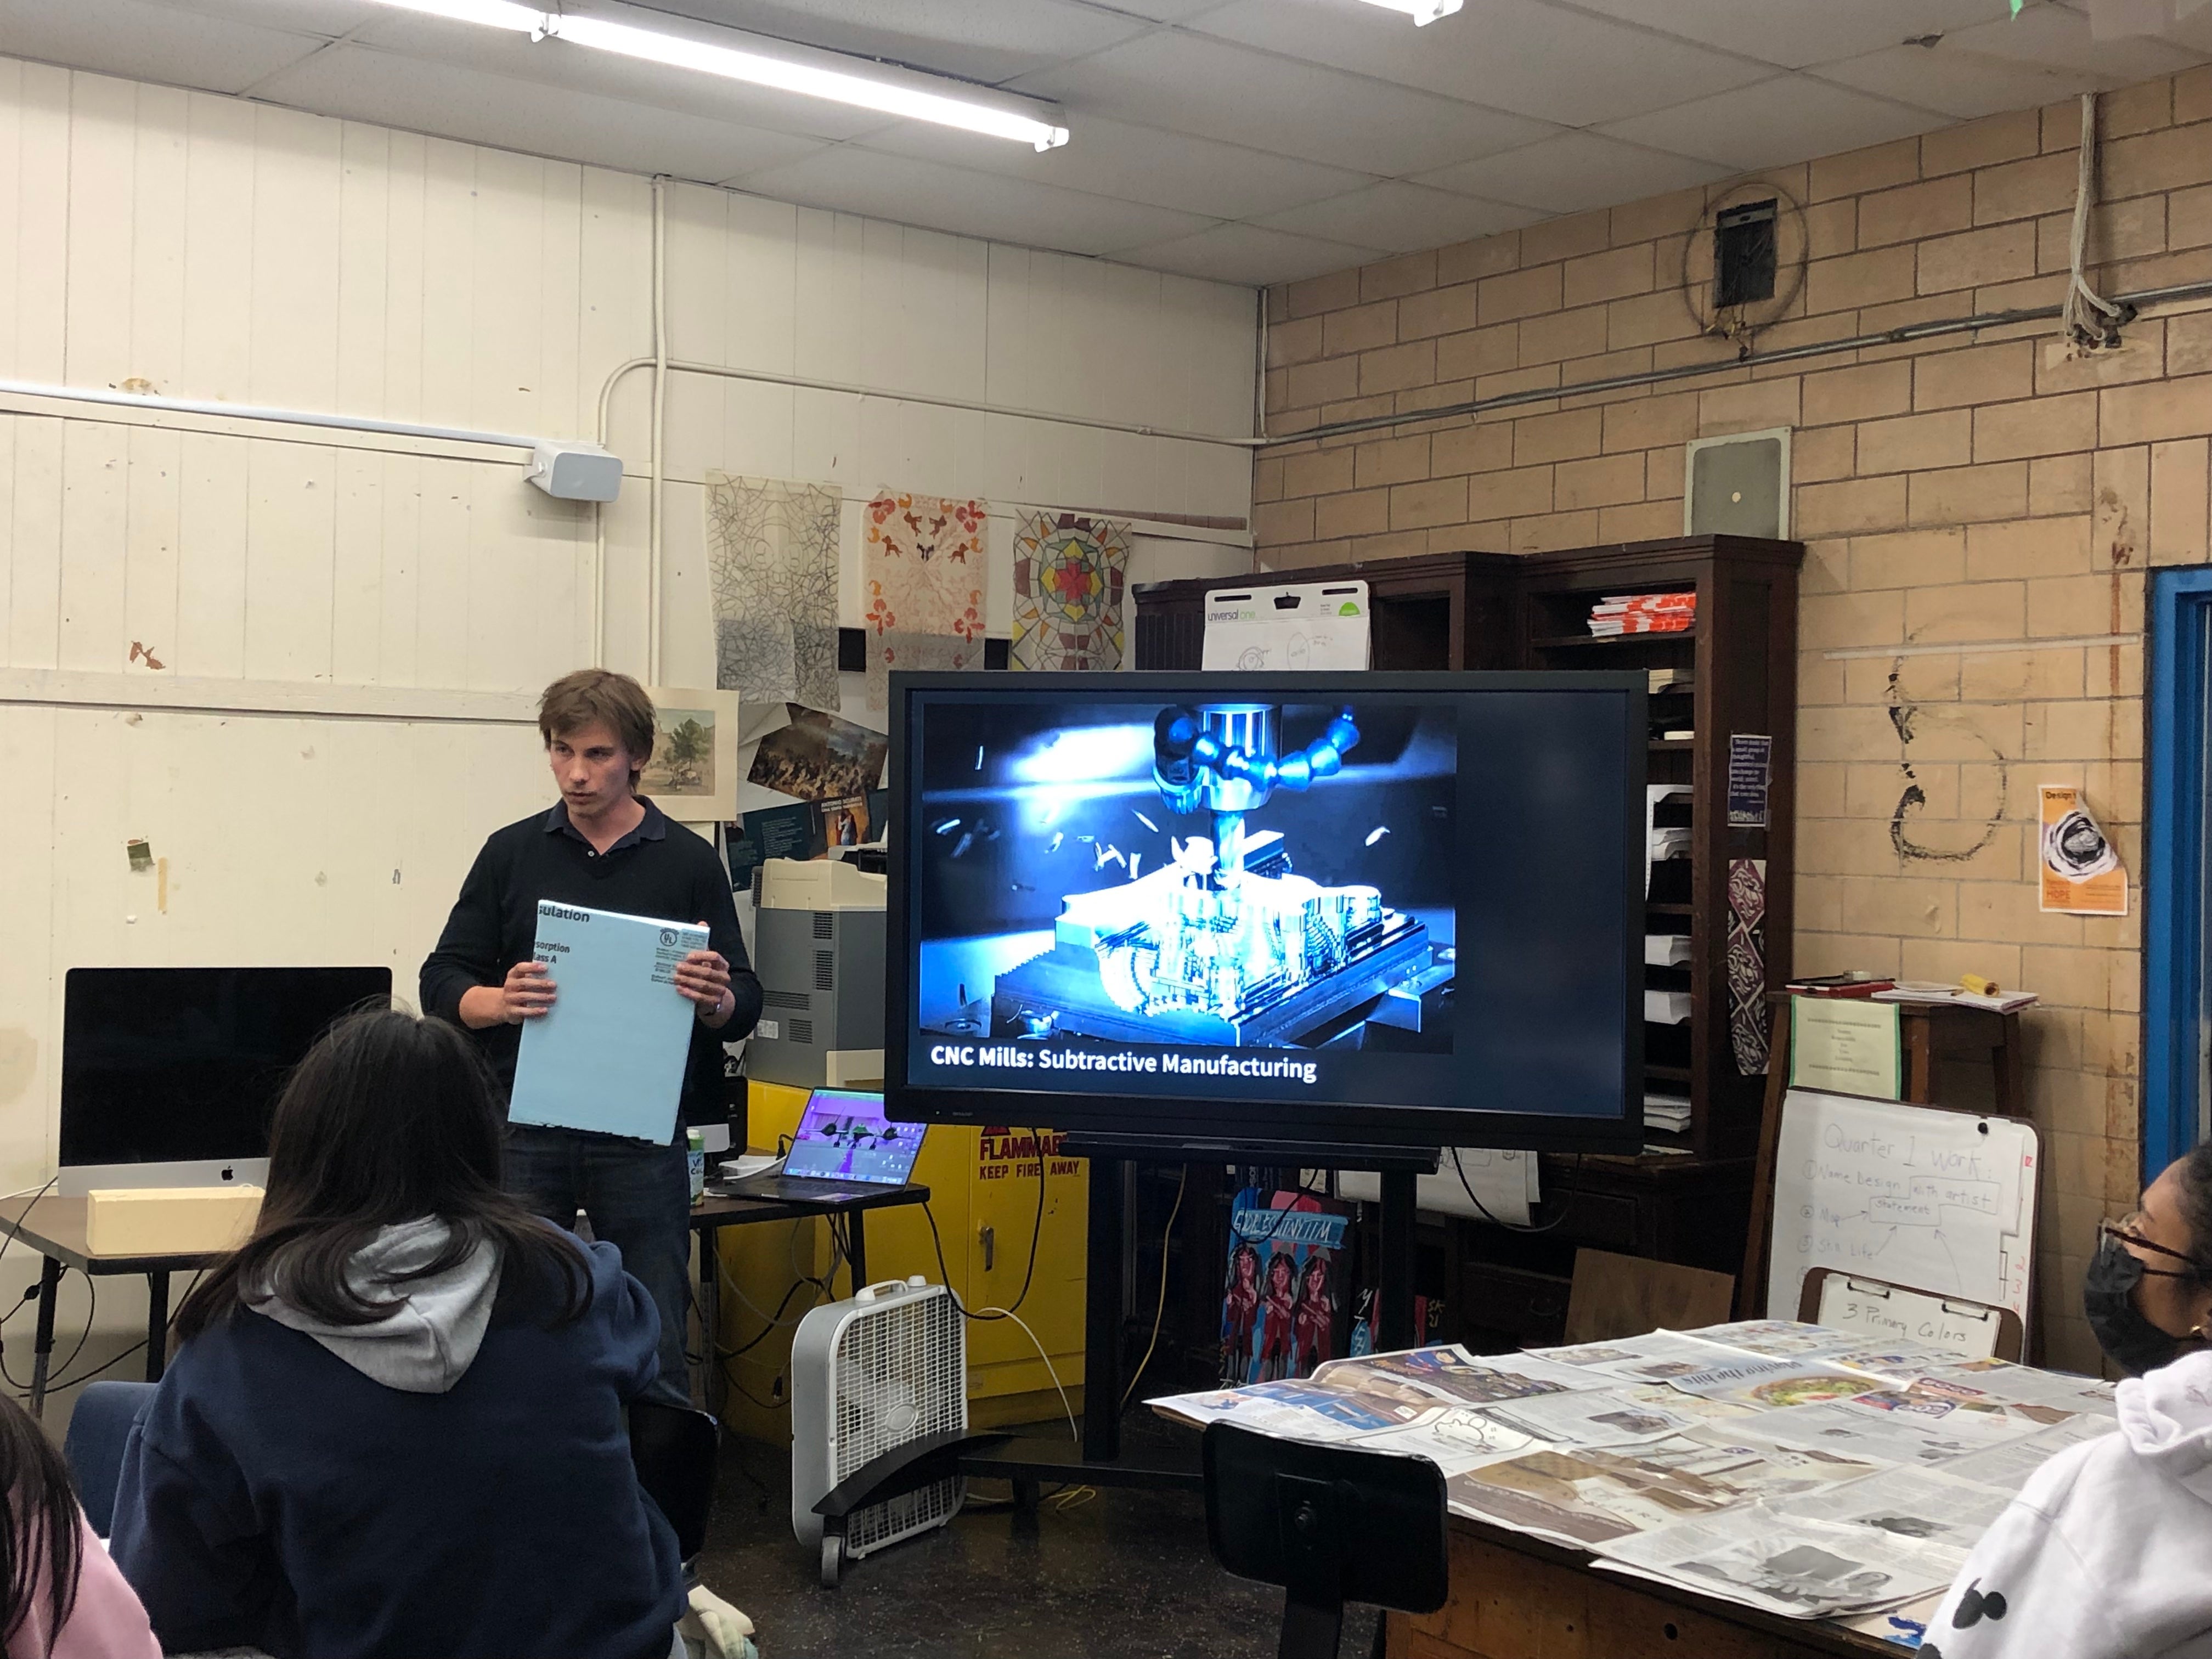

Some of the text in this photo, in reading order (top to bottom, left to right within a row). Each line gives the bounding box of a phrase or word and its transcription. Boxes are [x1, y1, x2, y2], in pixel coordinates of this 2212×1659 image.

[2045, 791, 2072, 800] Design
[2046, 889, 2070, 899] HOPE
[550, 955, 557, 963] A
[930, 1045, 1317, 1084] CNC Mills: Subtractive Manufacturing
[979, 1135, 1068, 1161] FLAMMAB
[1824, 1122, 1895, 1159] Quarter
[979, 1160, 1080, 1180] KEEP FIRE AWAY
[1817, 1164, 1852, 1184] Name
[1945, 1189, 1992, 1209] artist
[1842, 1303, 1967, 1342] 3 Primary Colors
[1716, 1368, 1745, 1380] the
